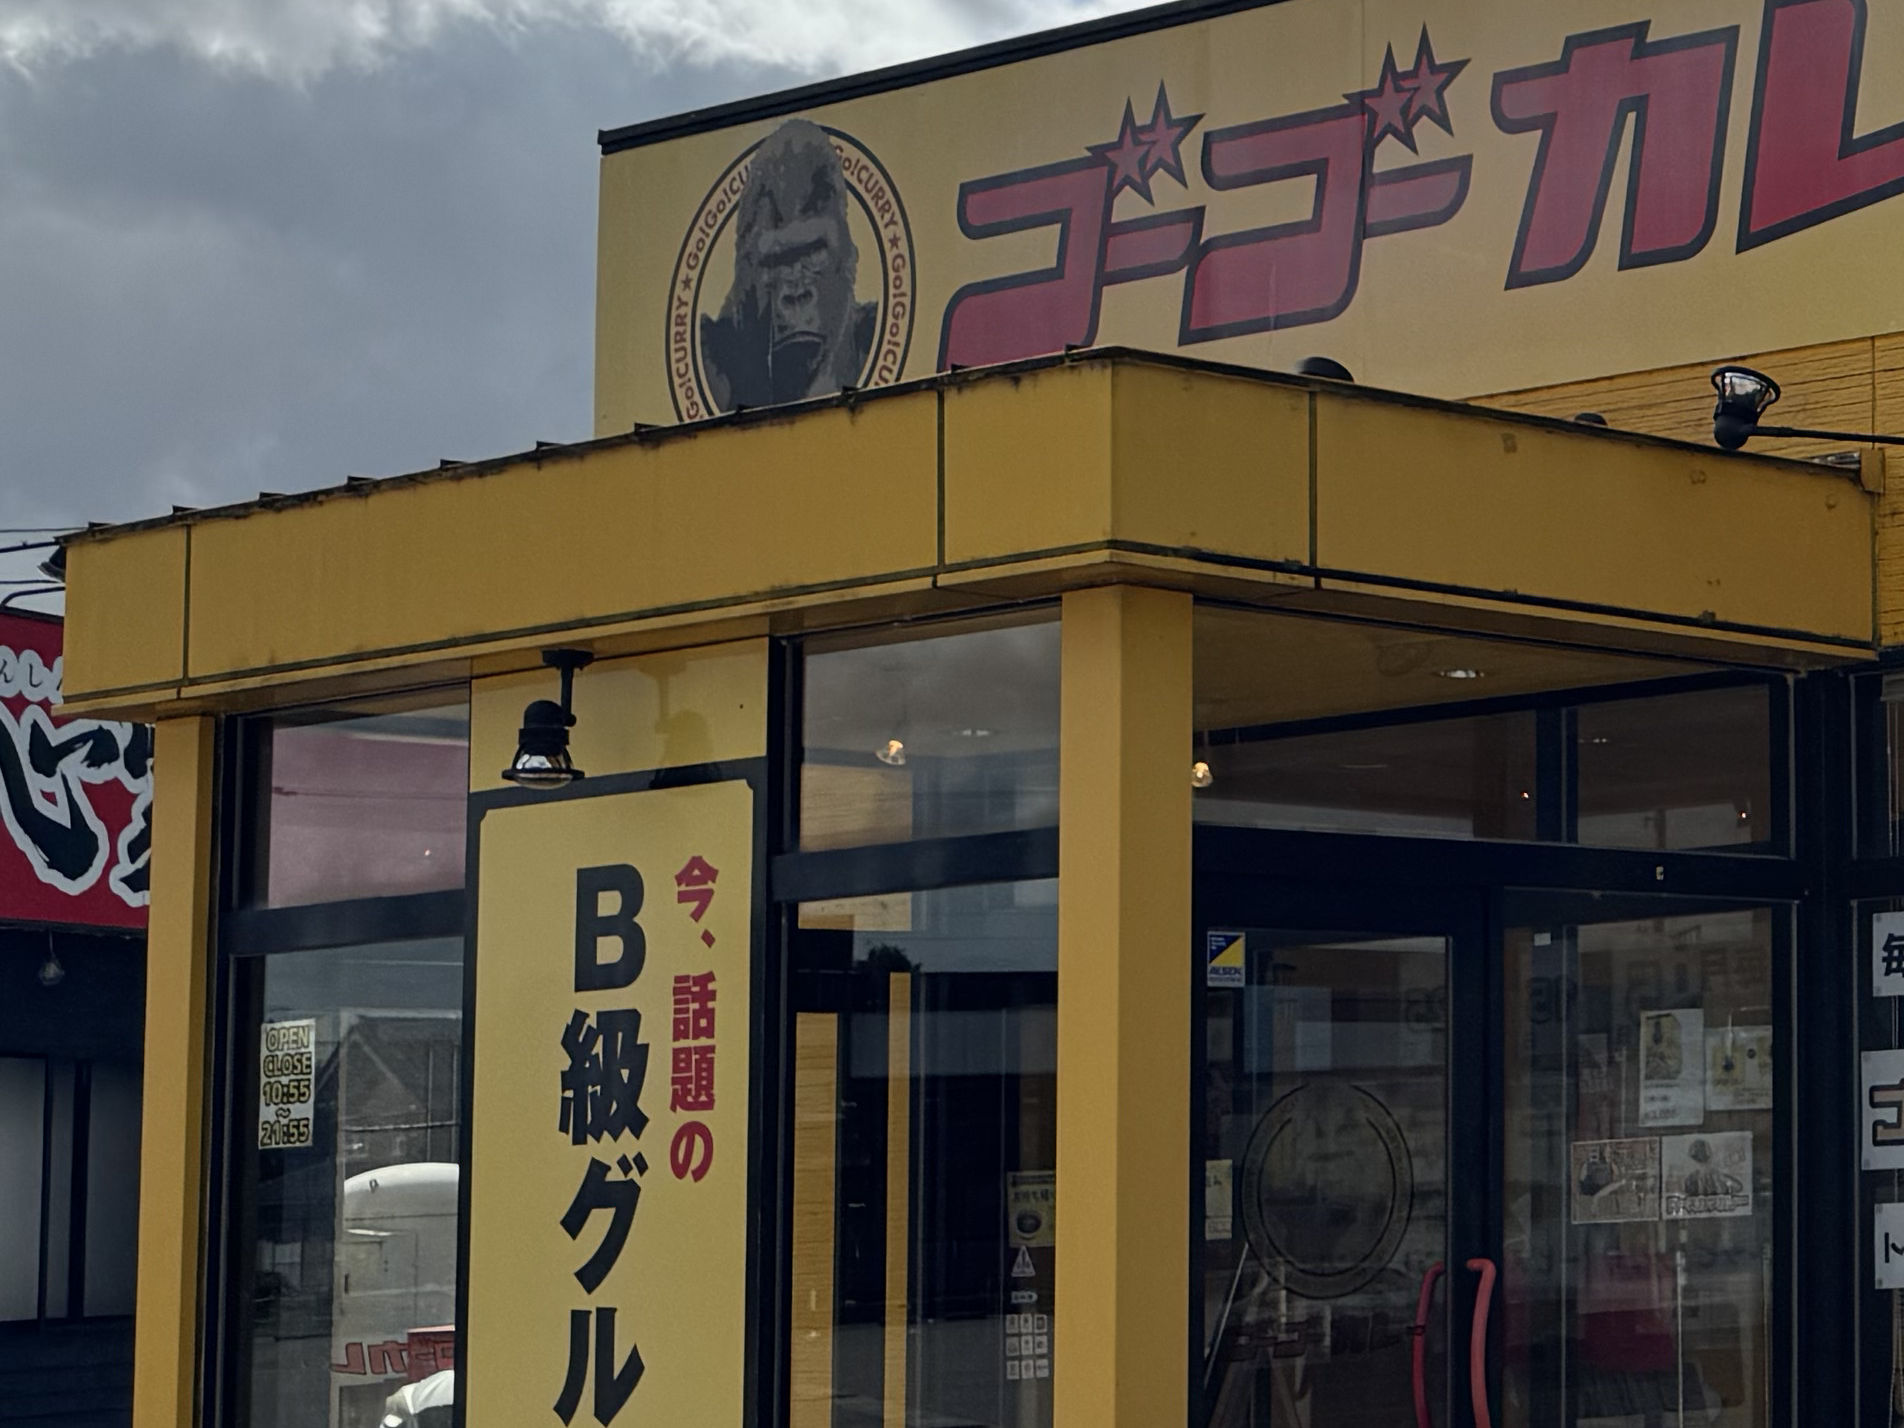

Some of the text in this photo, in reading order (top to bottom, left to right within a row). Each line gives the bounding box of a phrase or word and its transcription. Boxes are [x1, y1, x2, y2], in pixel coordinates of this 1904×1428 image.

[671, 854, 721, 1182] 今、話題の
[265, 1024, 311, 1053] OPEN
[262, 1051, 313, 1079] CLOSE
[262, 1078, 312, 1107] 10:55
[260, 1117, 311, 1147] 21:55
